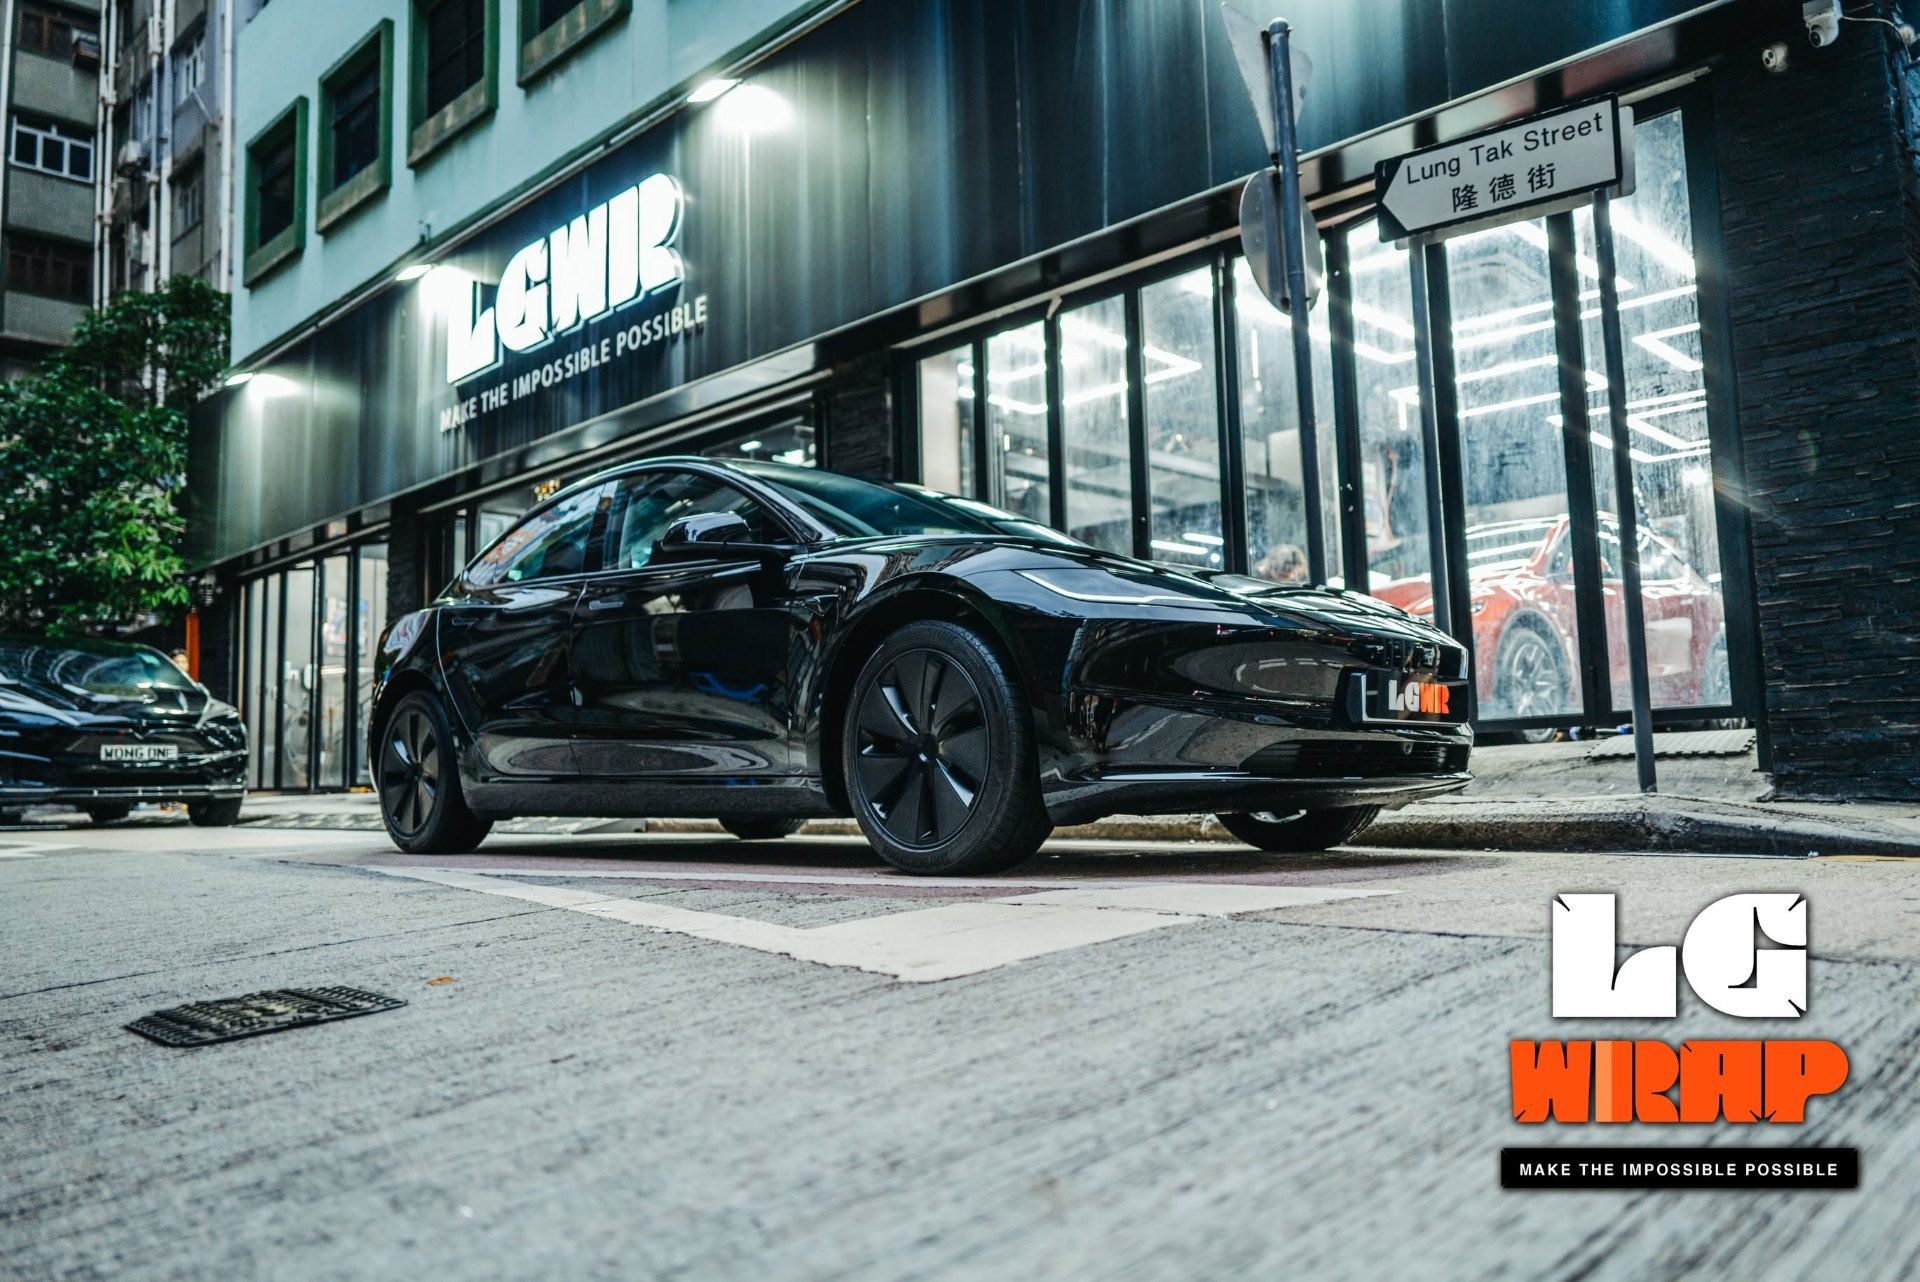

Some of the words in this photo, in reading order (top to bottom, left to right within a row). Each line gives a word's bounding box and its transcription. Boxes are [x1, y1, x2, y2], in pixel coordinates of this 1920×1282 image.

[1406, 156, 1461, 185] Lung
[1469, 140, 1514, 167] Tak
[1523, 111, 1604, 152] Street
[1451, 162, 1557, 213] 隆德街
[439, 396, 479, 433] MAKE
[480, 381, 510, 415] THE
[512, 335, 612, 401] IMPOSSIBLE
[615, 294, 708, 358] POSSIBLE
